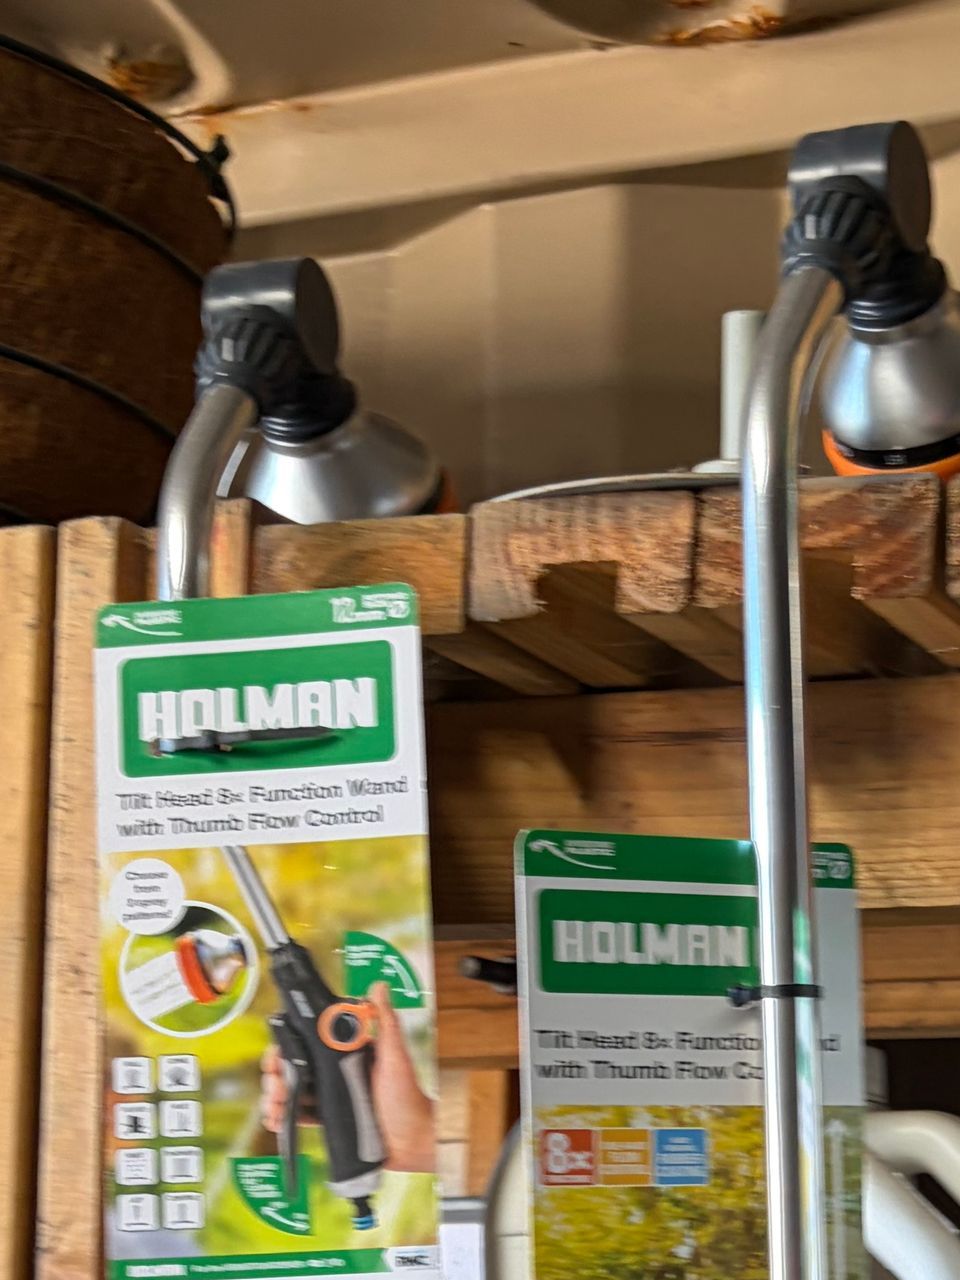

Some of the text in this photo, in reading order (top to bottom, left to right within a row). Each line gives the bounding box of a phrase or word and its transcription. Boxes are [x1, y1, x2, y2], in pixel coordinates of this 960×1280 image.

[138, 677, 380, 742] HOLMAN
[116, 793, 152, 810] Tilt
[156, 788, 213, 808] Head
[249, 781, 344, 802] Function
[346, 776, 410, 796] Wand
[168, 815, 246, 834] Thumb
[248, 811, 301, 830] Flow
[304, 805, 385, 827] Control
[552, 919, 751, 968] HOLMAN
[533, 1029, 574, 1049] Tilt
[576, 1030, 640, 1049] Head
[676, 1031, 767, 1052] Functio
[534, 1060, 588, 1079] with
[589, 1059, 672, 1079] Thumb
[674, 1060, 729, 1080] Flow
